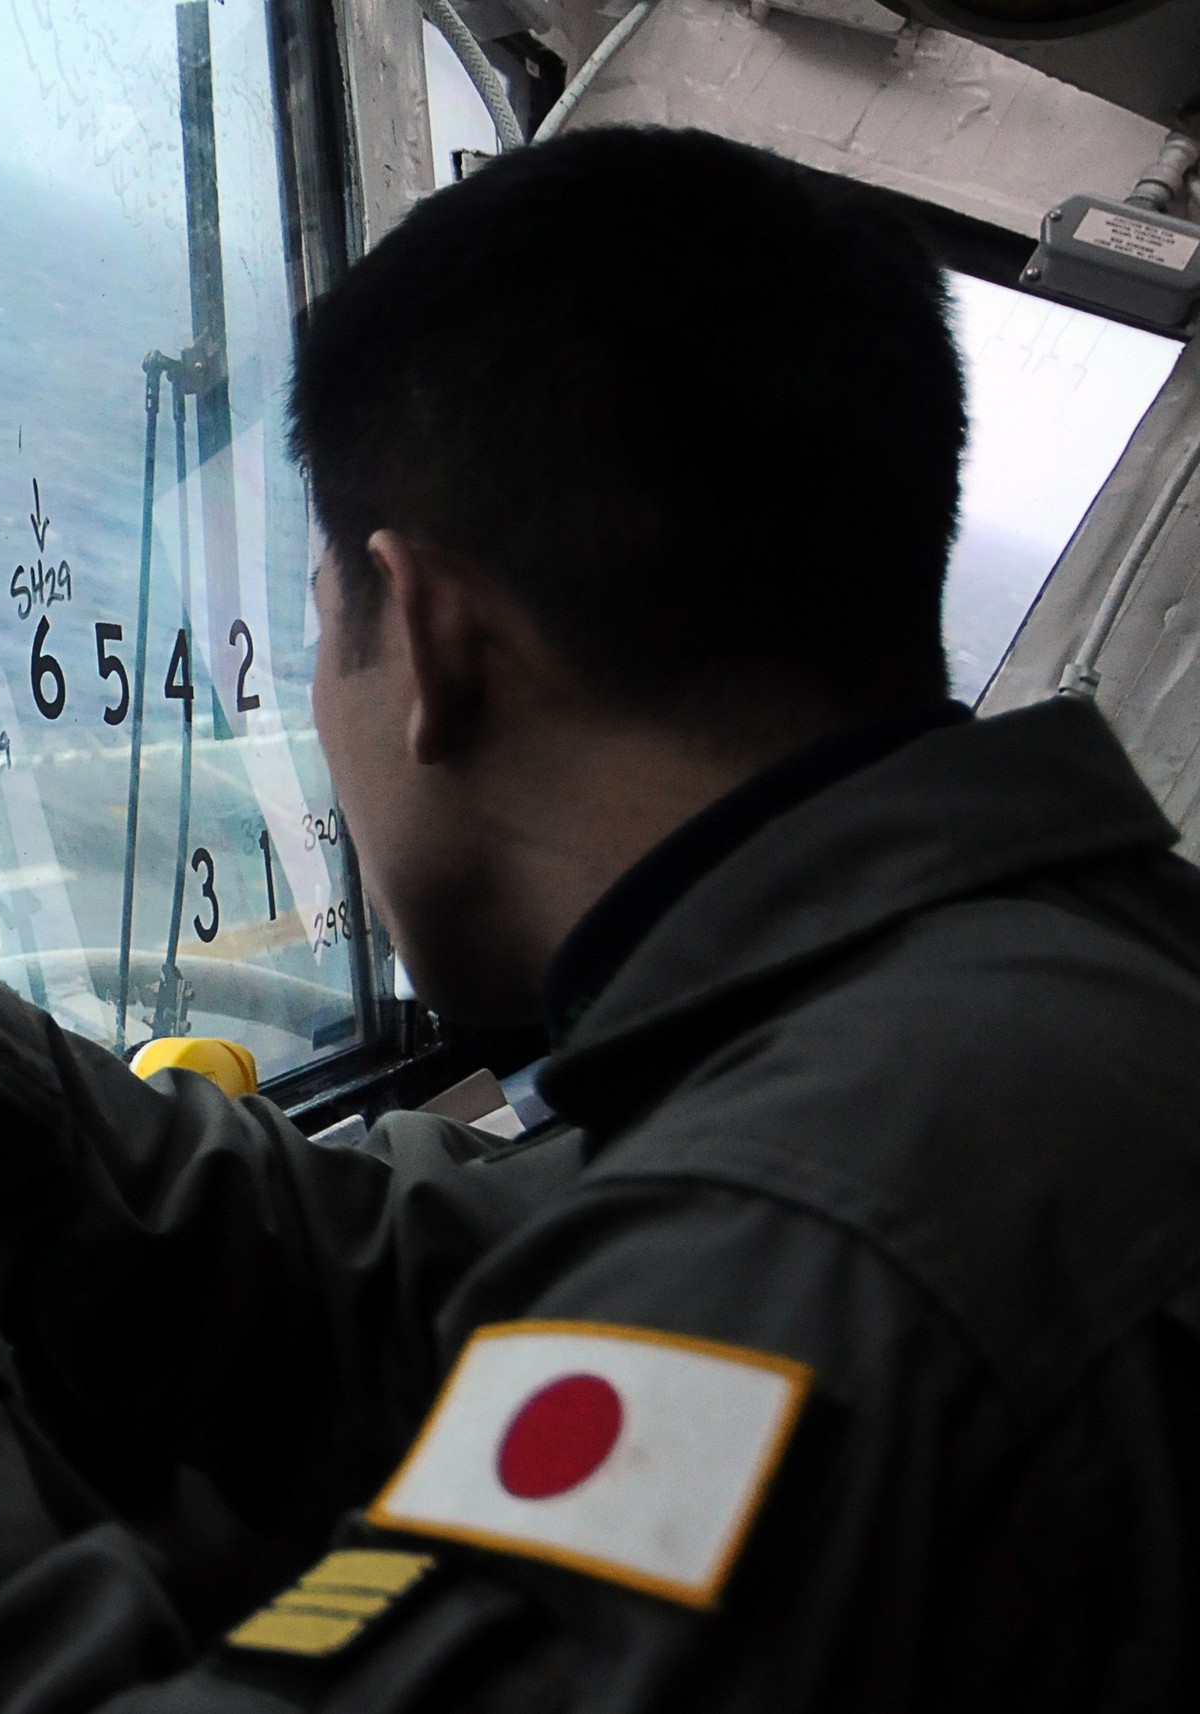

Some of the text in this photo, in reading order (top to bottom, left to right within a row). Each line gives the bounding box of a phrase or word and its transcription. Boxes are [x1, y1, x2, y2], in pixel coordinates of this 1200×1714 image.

[30, 614, 66, 720] 6
[95, 622, 130, 726] 5
[164, 628, 195, 722] 4
[229, 619, 261, 713] 2
[191, 847, 220, 943] 3
[258, 829, 277, 921] 1
